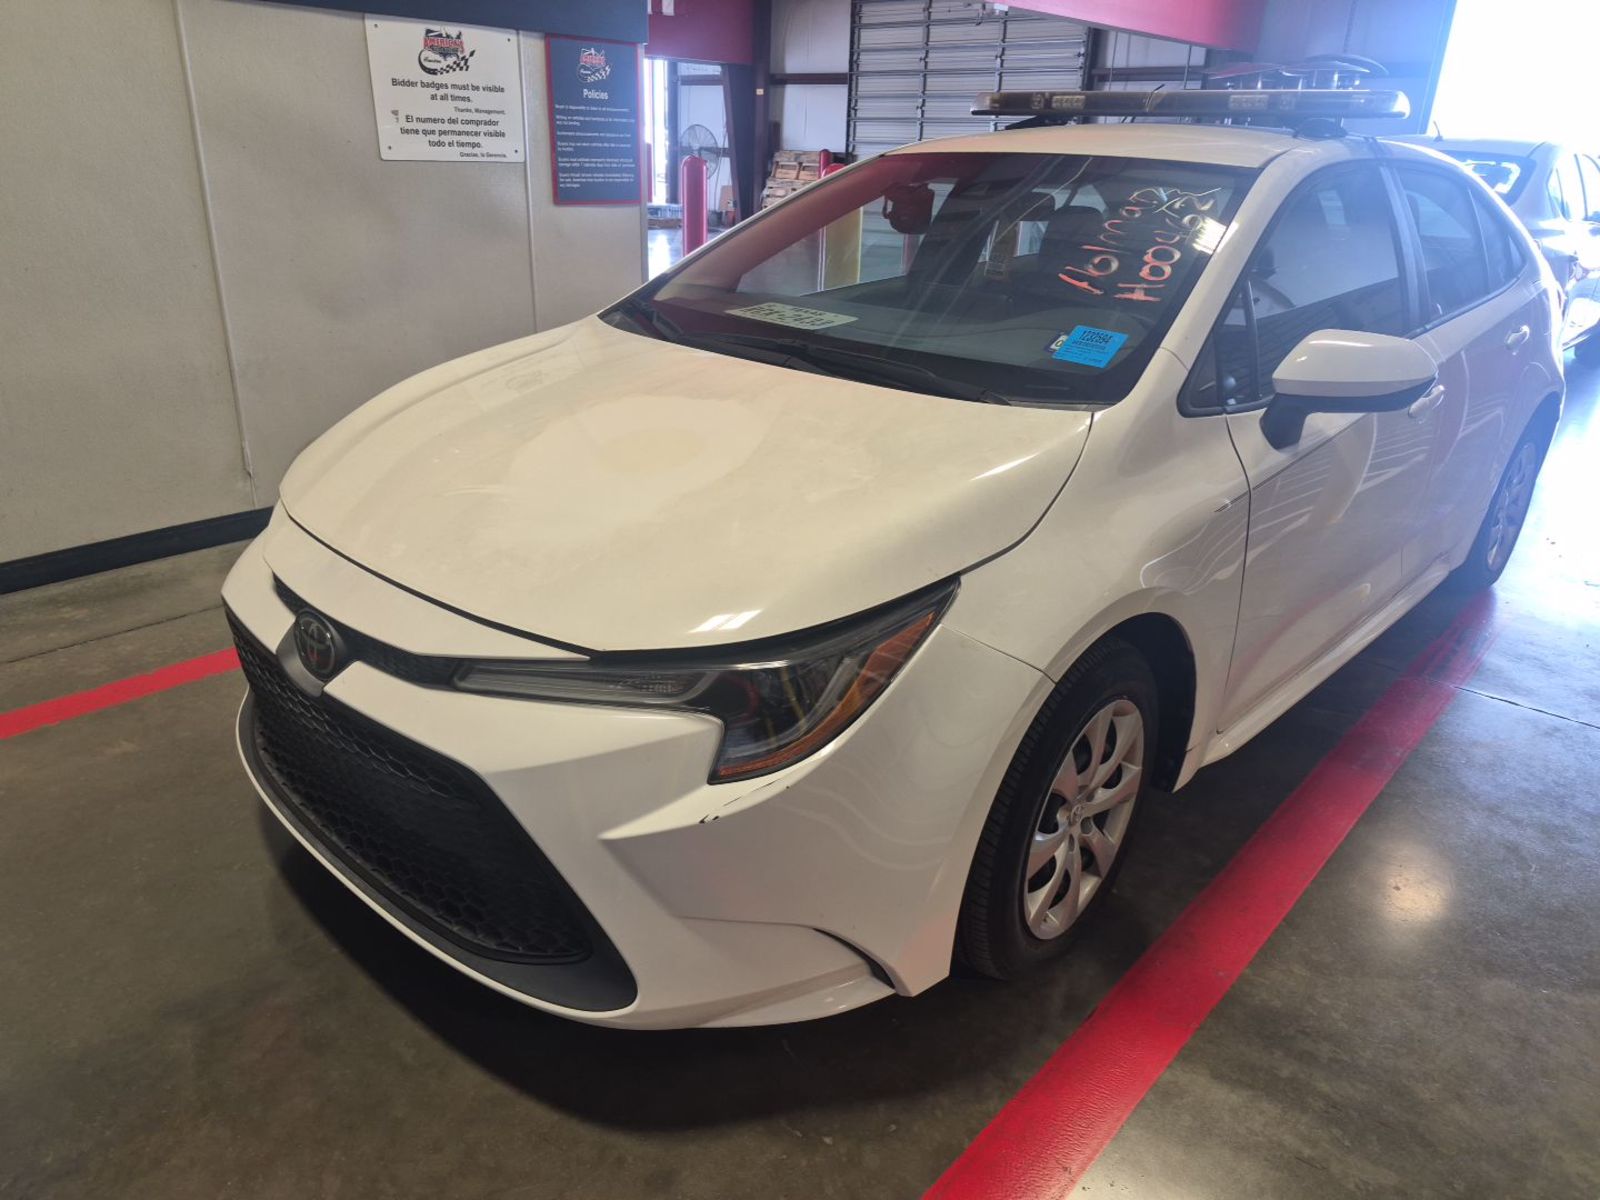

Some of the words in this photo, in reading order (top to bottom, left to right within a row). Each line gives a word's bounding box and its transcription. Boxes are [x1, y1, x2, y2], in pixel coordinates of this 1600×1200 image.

[391, 78, 418, 88] Bidder
[420, 80, 449, 90] badges
[450, 83, 470, 91] must
[471, 83, 480, 92] be
[482, 85, 505, 93] visible
[430, 93, 438, 101] at
[439, 93, 449, 101] all
[450, 94, 473, 102] times.
[583, 88, 609, 100] Policies
[405, 115, 413, 123] El
[415, 117, 446, 125] numero
[447, 117, 459, 125] del
[460, 118, 500, 127] comprador
[400, 127, 420, 135] tiene
[421, 128, 437, 137] que
[438, 129, 481, 138] permanecer
[483, 129, 506, 138] visible
[428, 139, 446, 147] todo
[447, 140, 455, 148] el
[455, 140, 483, 149] tiempo.
